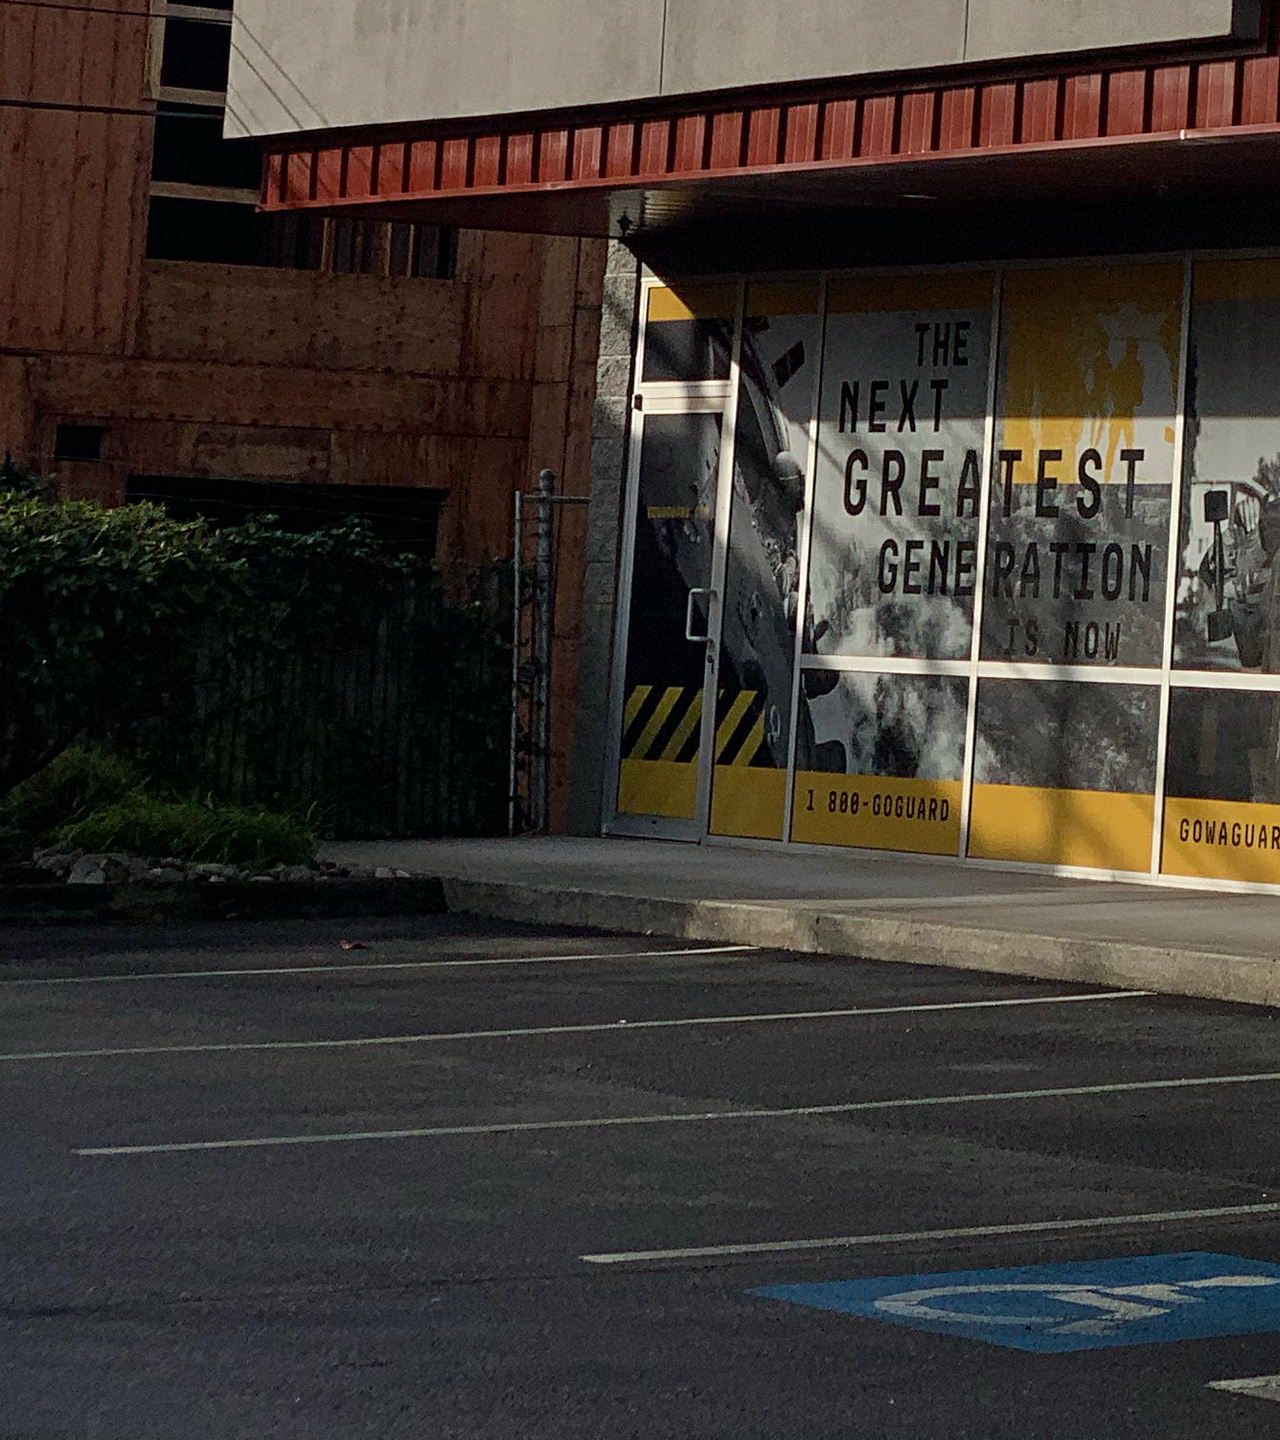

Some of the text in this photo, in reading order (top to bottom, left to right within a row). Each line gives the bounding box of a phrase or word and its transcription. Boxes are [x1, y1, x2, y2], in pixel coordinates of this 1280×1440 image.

[915, 321, 971, 366] THE
[839, 379, 949, 433] NEXT
[843, 448, 1145, 519] GREATEST
[878, 538, 1153, 602] GENERATION
[1004, 619, 1121, 660] IS NOW
[806, 790, 950, 823] 1 800-GOGUARD
